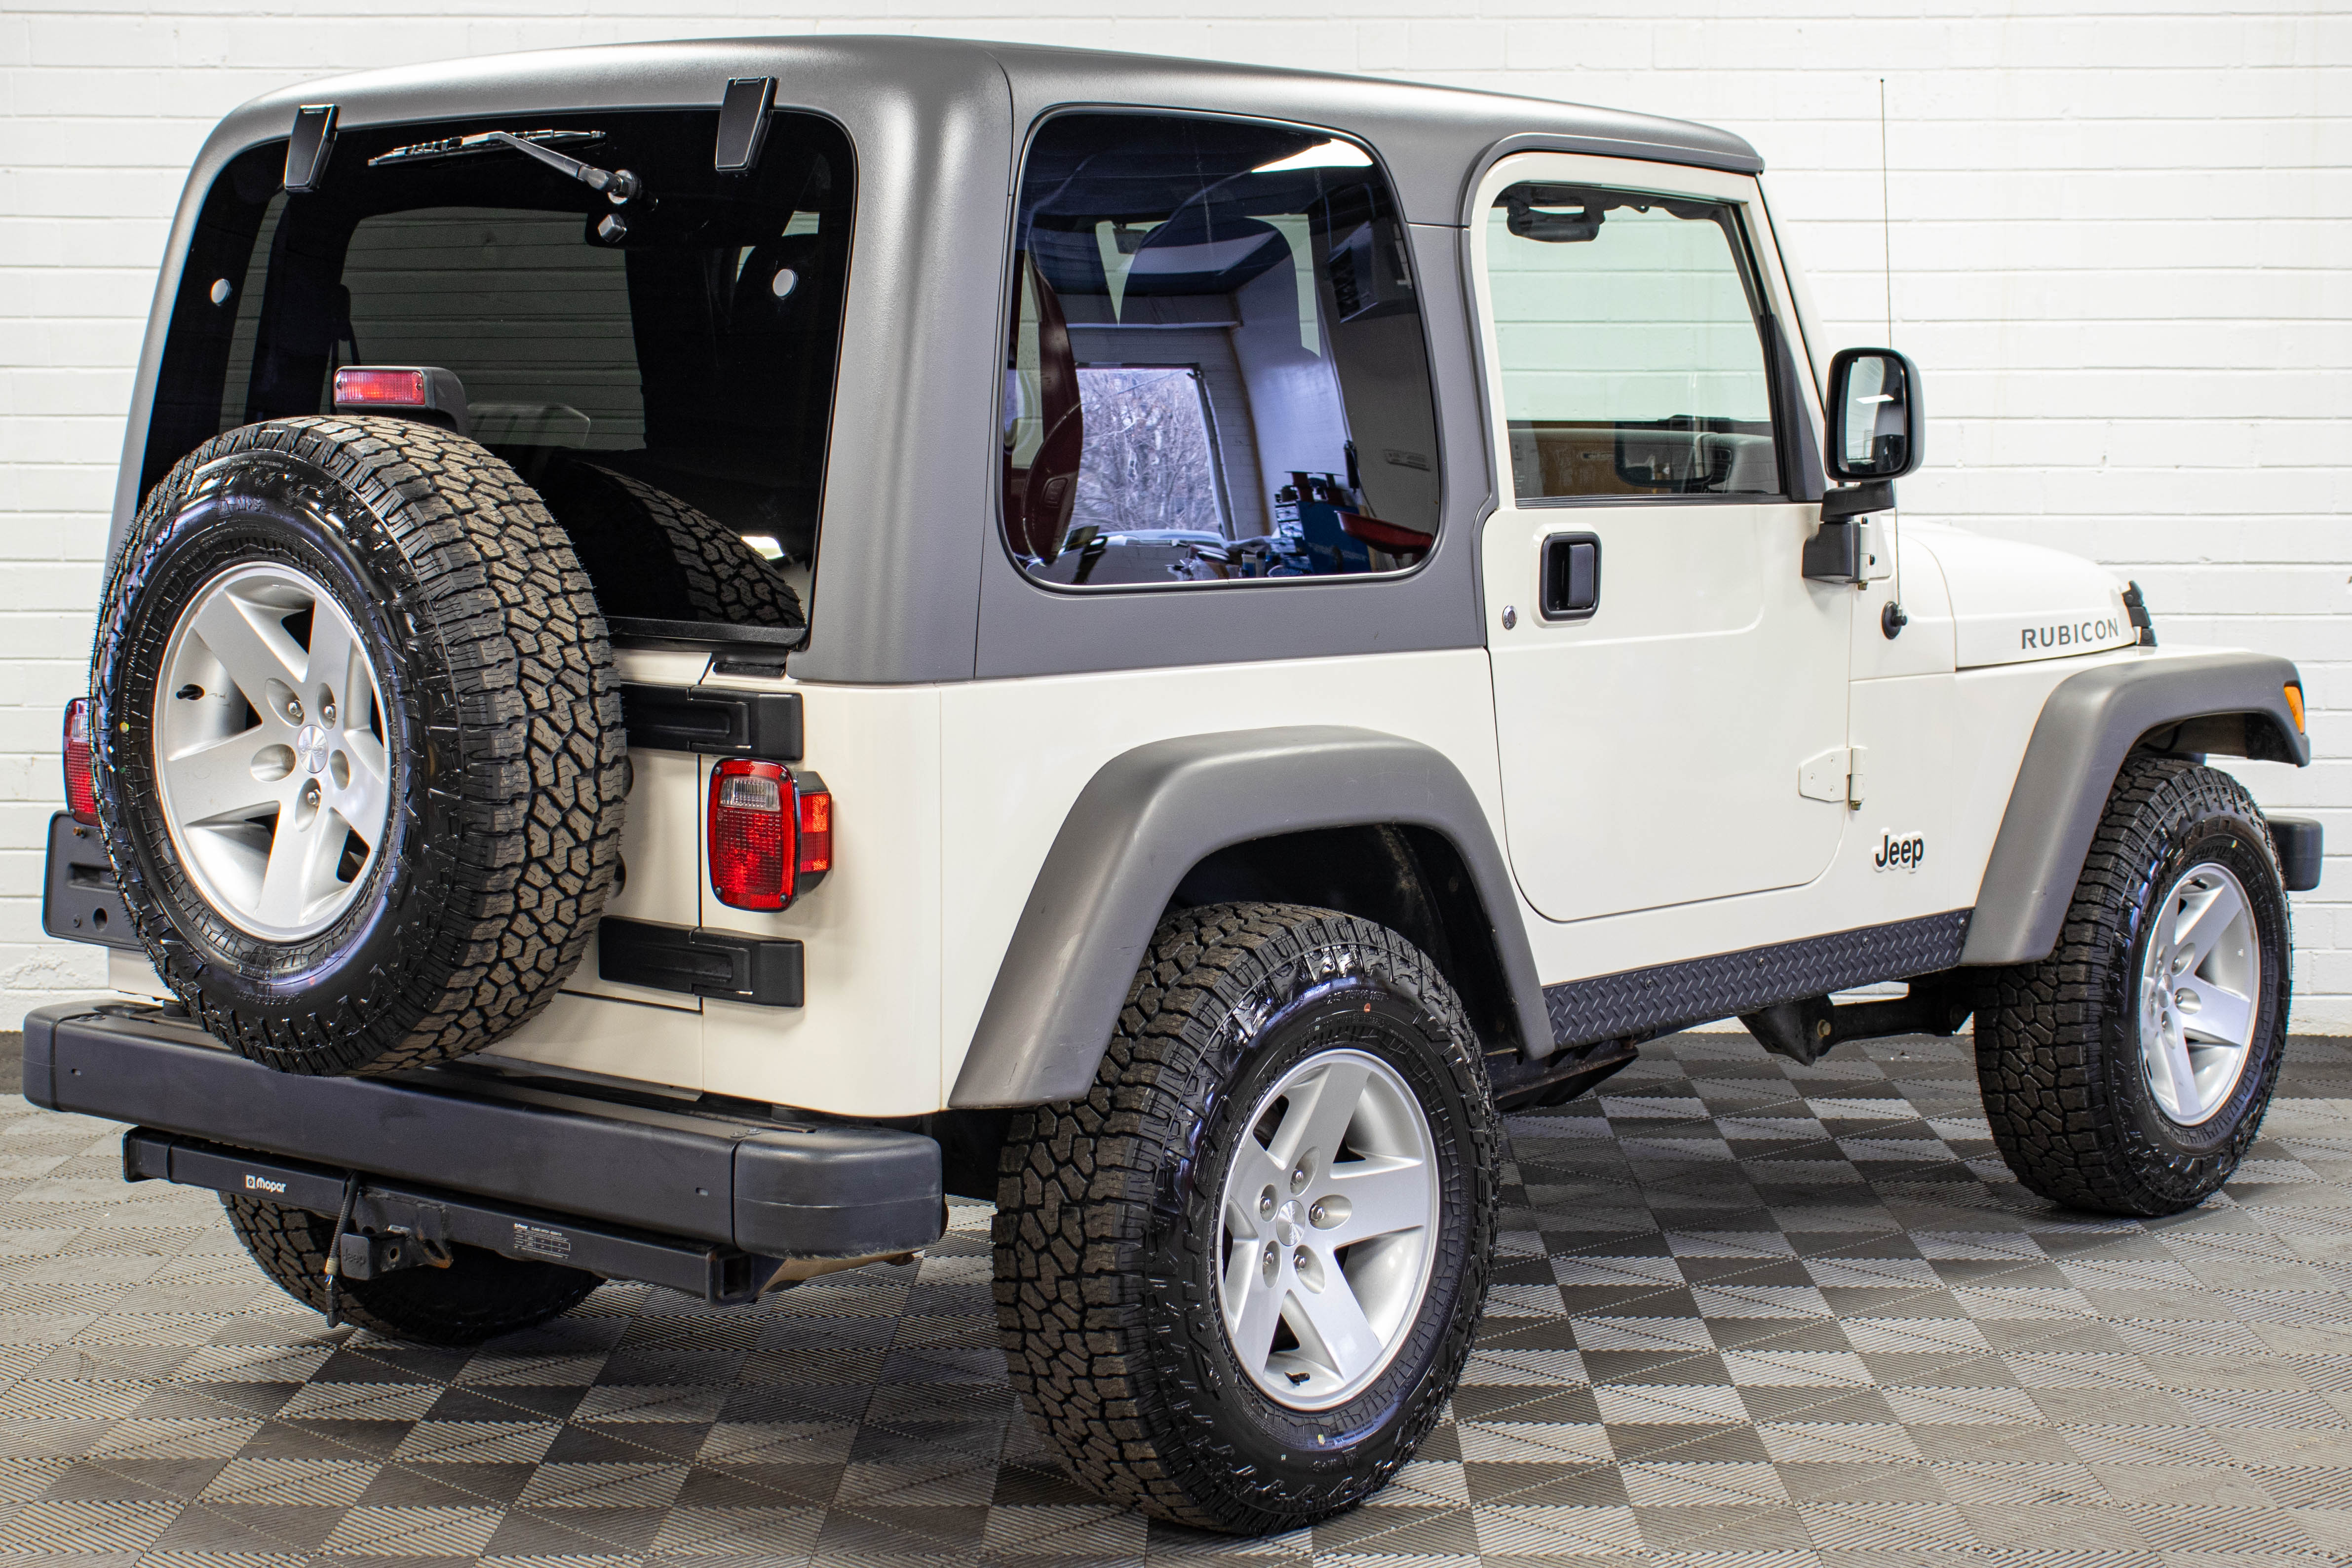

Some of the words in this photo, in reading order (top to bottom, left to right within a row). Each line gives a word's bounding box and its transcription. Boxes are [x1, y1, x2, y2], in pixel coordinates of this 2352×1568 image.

[2021, 618, 2119, 649] RUBICON
[1875, 835, 1924, 868] Jeep
[256, 1177, 286, 1192] Mopar
